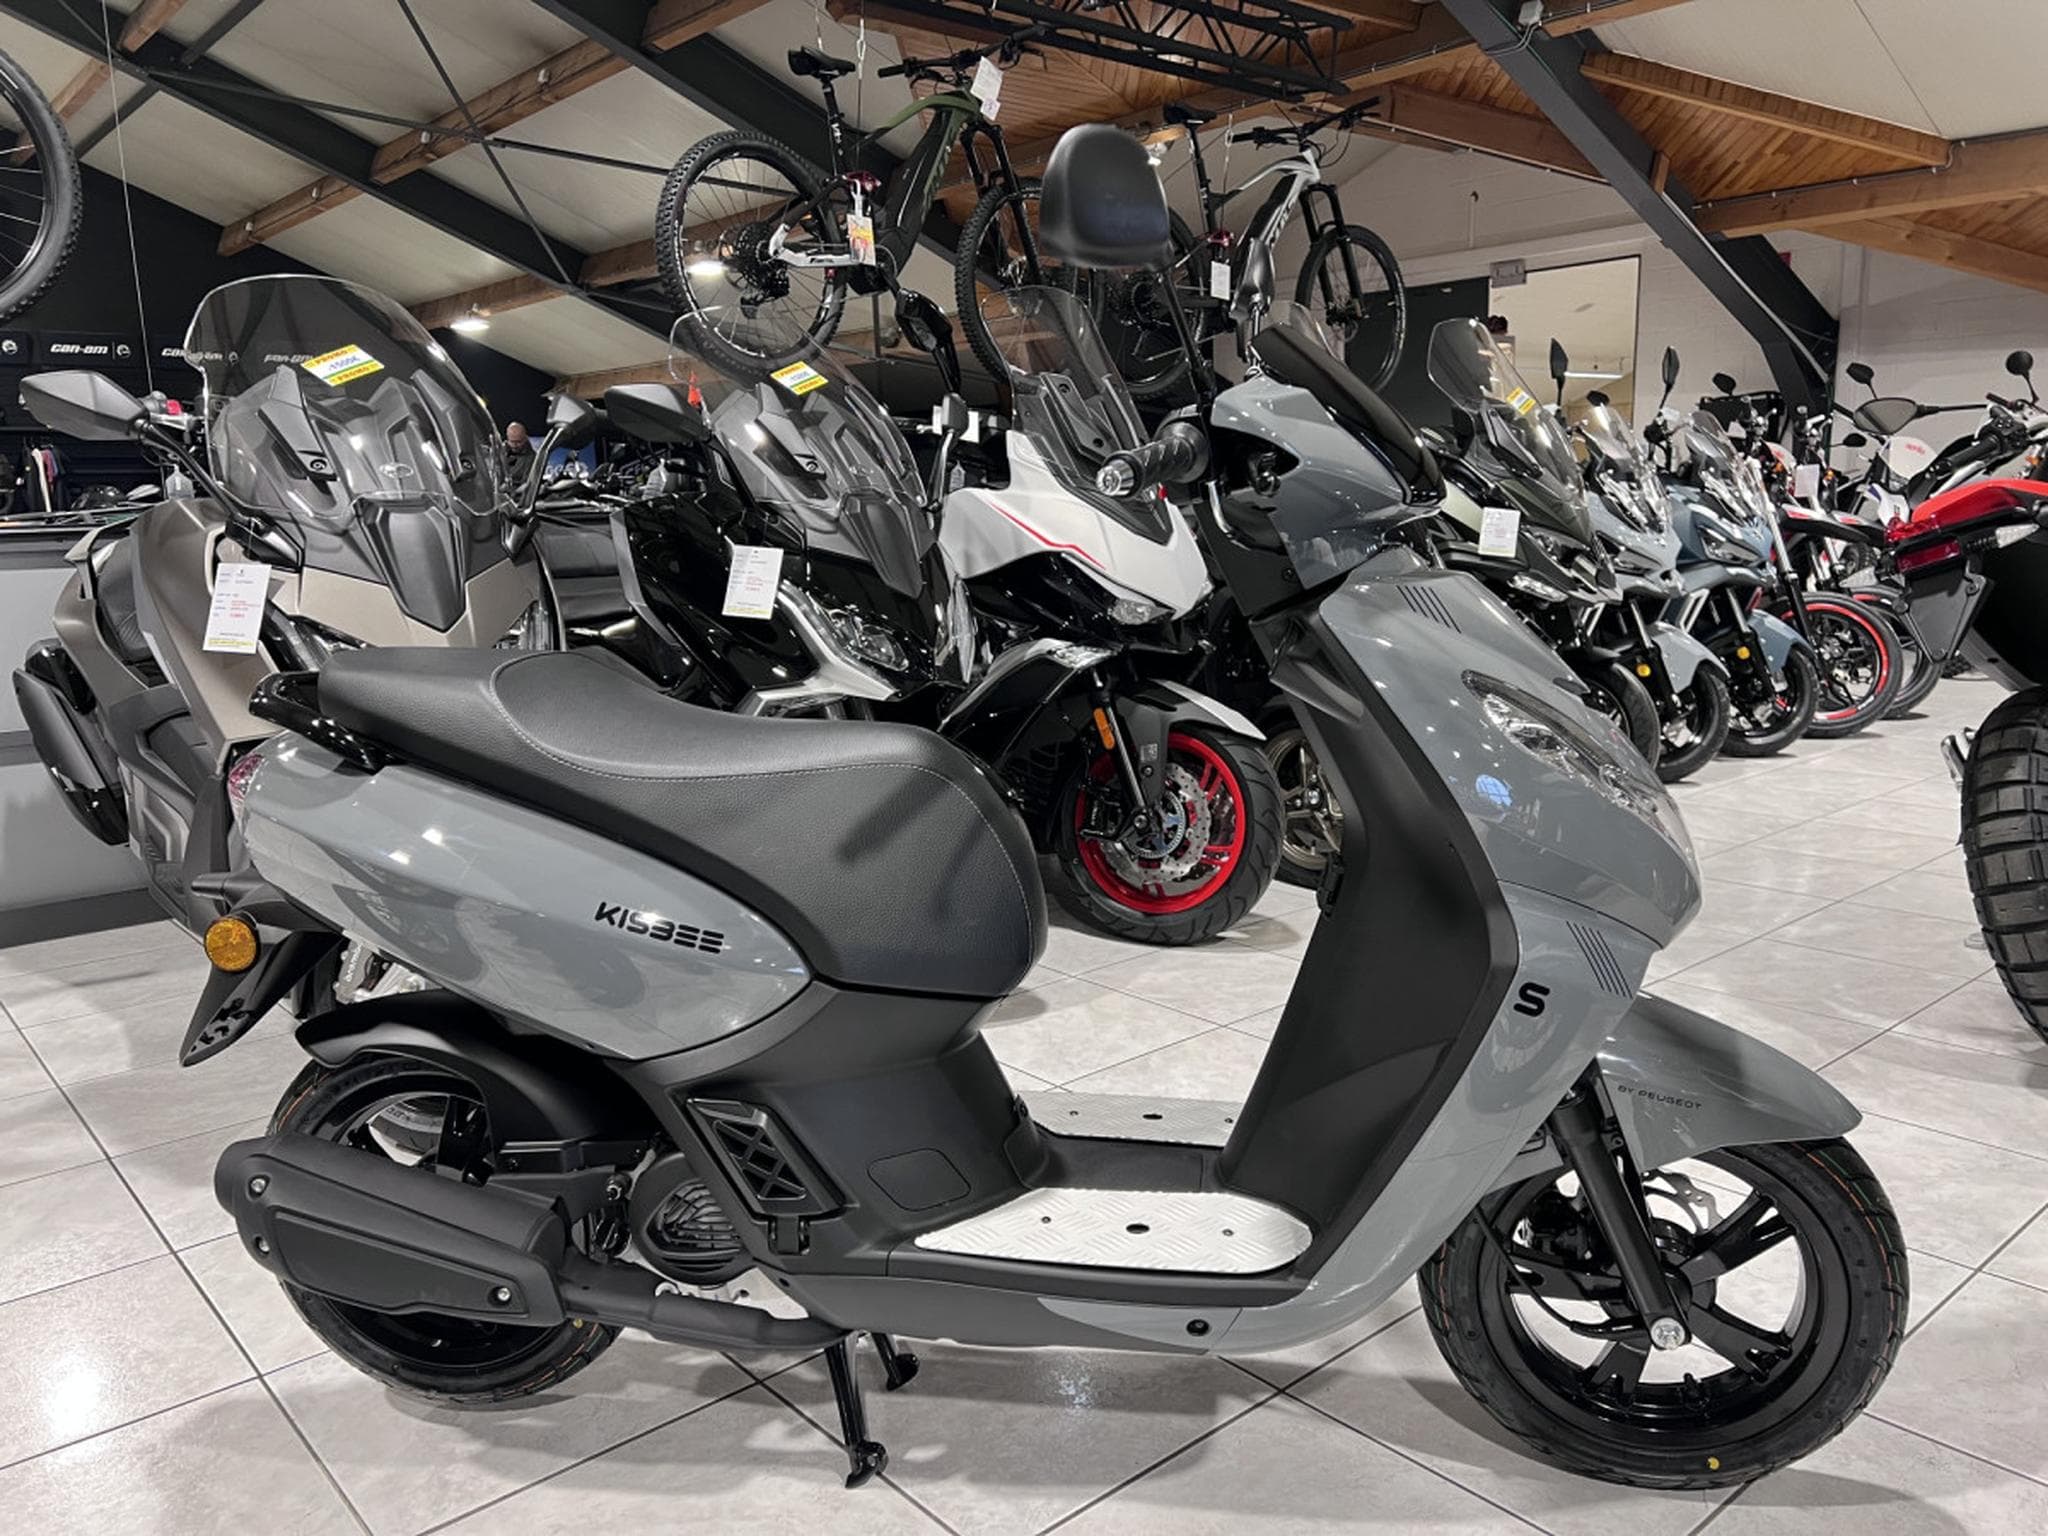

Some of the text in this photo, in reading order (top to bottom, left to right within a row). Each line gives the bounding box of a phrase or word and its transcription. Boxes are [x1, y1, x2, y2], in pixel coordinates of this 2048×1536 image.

[594, 901, 725, 955] KISBEE
[1513, 981, 1551, 1018] S
[1617, 1084, 1702, 1110] BY PEUGEOT
